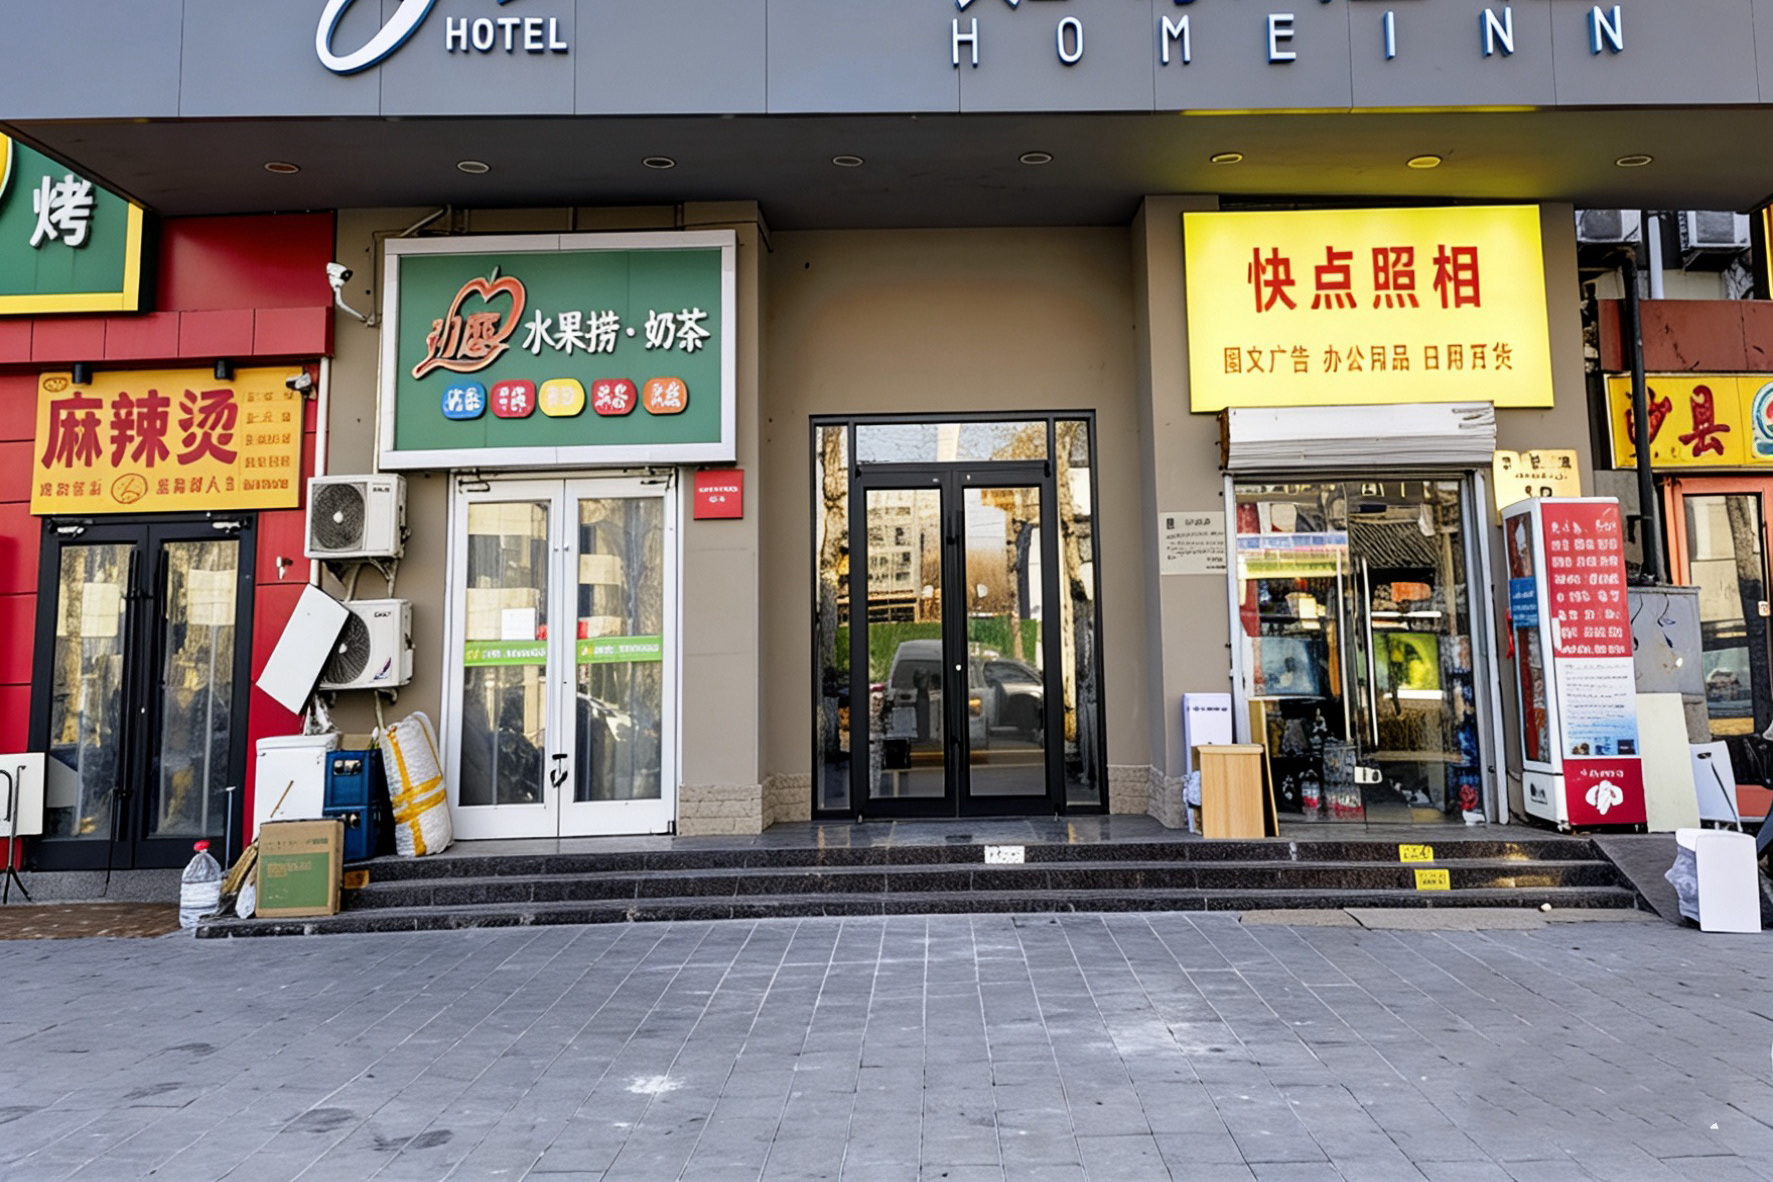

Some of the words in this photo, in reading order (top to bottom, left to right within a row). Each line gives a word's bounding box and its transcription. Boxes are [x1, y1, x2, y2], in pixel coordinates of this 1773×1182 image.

[446, 16, 569, 53] HOTEL
[29, 173, 94, 248] 烤
[1247, 243, 1482, 313] 快点照相
[1323, 343, 1411, 373] 办公用品
[1424, 341, 1514, 372] 日用百货
[41, 387, 239, 470] 麻辣烫
